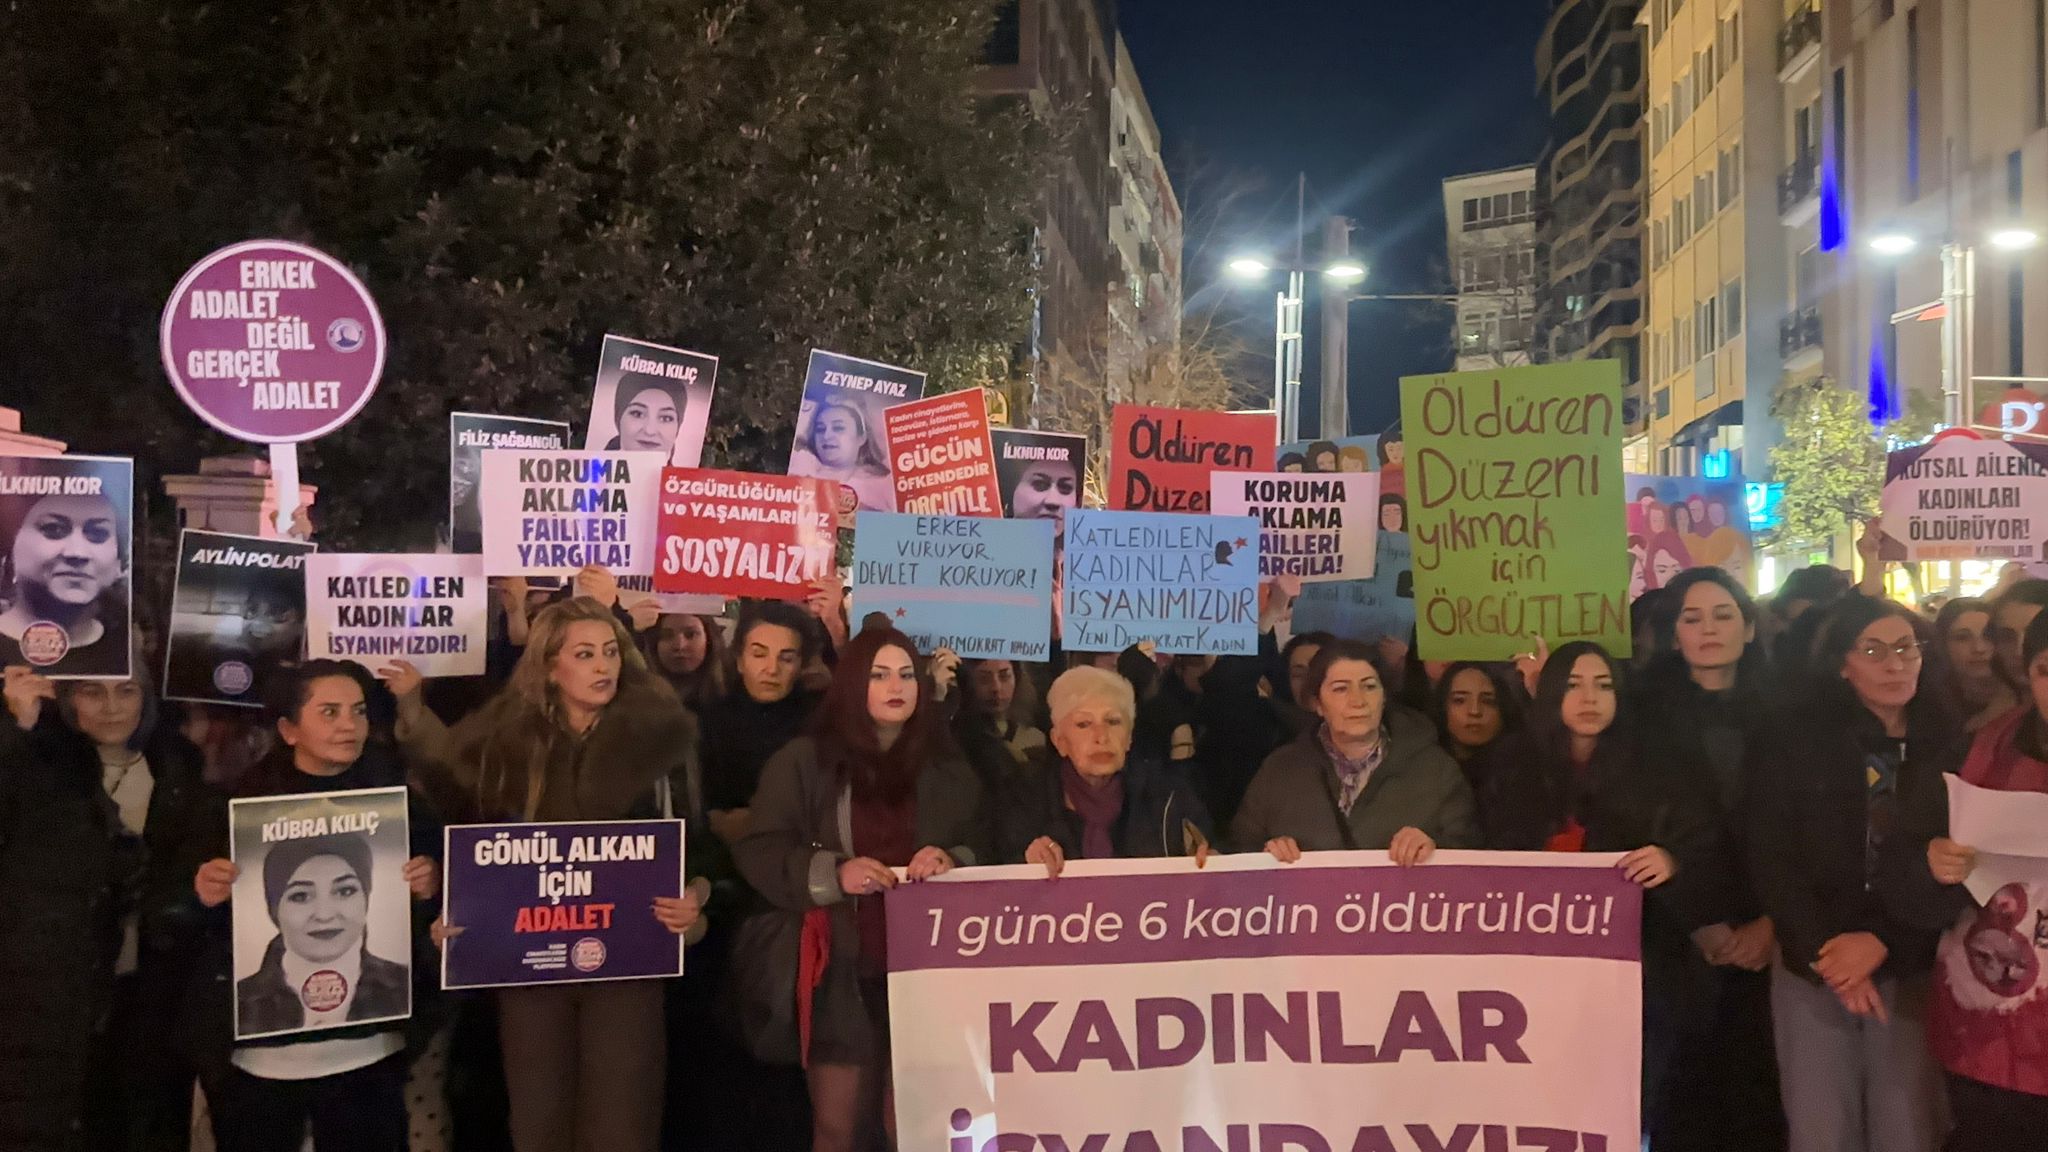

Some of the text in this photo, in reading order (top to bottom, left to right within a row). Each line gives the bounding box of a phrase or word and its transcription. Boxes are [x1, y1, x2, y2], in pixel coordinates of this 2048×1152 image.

[240, 260, 316, 289] ERKEK
[190, 291, 279, 318] ADALET
[247, 316, 314, 350] DEĞİL
[187, 350, 280, 387] GERÇEK
[620, 355, 698, 384] KÜBRA KILIÇ
[253, 381, 340, 410] ADALET
[823, 370, 908, 397] ZEYNEP AYAZ
[1422, 378, 1613, 438] Öldüren
[458, 429, 489, 446] FİLİZ
[1003, 442, 1069, 461] İLKNUR KOR
[1129, 414, 1253, 468] Öldüren
[897, 436, 983, 472] GÜCÜN
[0, 472, 102, 495] LKNUR KOR
[519, 458, 631, 483] KORUMA
[897, 461, 990, 492] ÖFKENDEDİR
[522, 488, 628, 512] AKLAMA
[665, 476, 815, 504] ÖZGÜRLÜĞÜMÜZ
[1245, 480, 1346, 502] KORUMA
[1918, 487, 2020, 510] KADINLARI
[664, 503, 685, 516] ve
[916, 517, 982, 538] ERKEK
[1416, 501, 1556, 571] yıkmak
[1909, 515, 2030, 541] ÖLDÜRÜYOR!
[517, 544, 631, 567] YARGILA!
[1259, 530, 1340, 555] AİLLERİ
[191, 547, 304, 570] AYLİN POLAT
[1069, 553, 1221, 583] KADINLAR
[1259, 555, 1343, 576] ARGILA!
[1491, 553, 1546, 585] için
[859, 563, 1037, 589] DEVLET KORUYOR!
[337, 605, 453, 627] KADINLAR
[1070, 586, 1258, 625] İSYANIMIZDIR
[1426, 588, 1627, 638] ÖRGÜTLEN
[328, 632, 467, 655] İSYANIMIZDIR!
[262, 811, 379, 843] KÜBRA KILIÇ
[474, 832, 655, 866] GÖNÜL ALKAN
[538, 866, 592, 904] İÇİN
[514, 904, 614, 933] ADALET
[927, 890, 1614, 957] 1 günde 6 kadın öldürüldü!
[988, 989, 1531, 1074] KADINLAR
